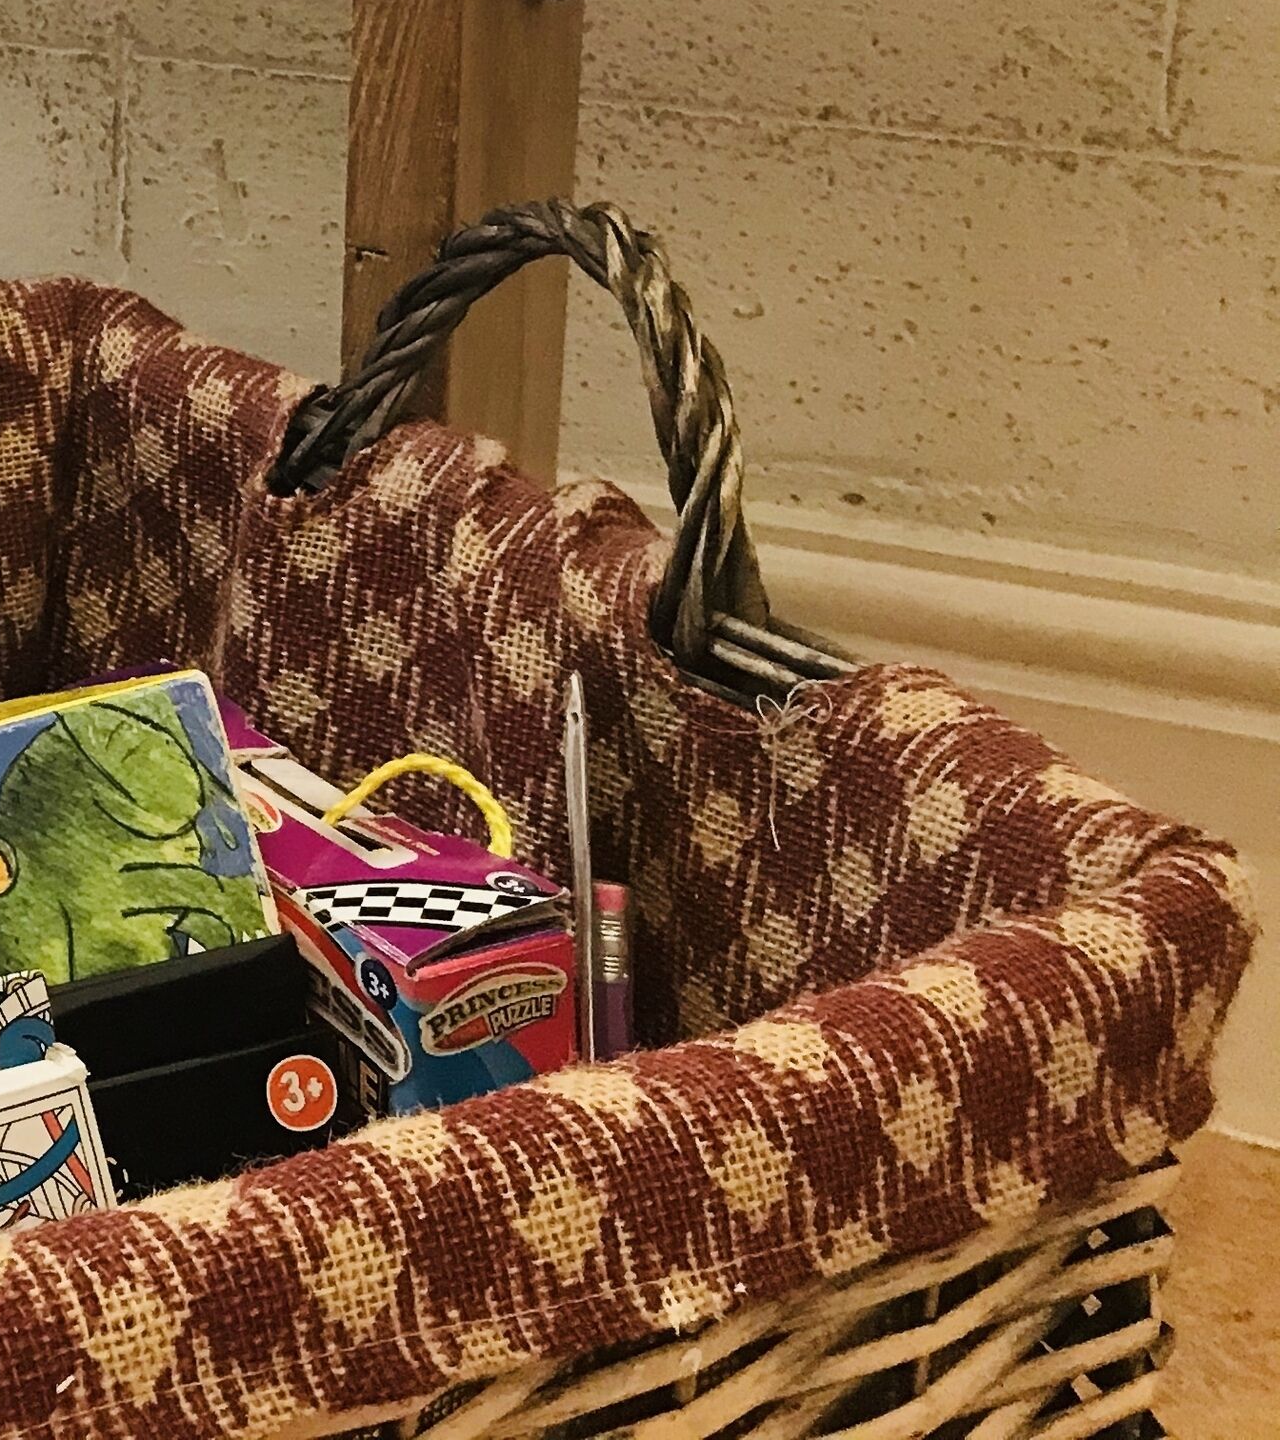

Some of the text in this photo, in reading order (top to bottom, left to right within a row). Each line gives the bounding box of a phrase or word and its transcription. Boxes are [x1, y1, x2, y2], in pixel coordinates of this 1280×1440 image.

[369, 971, 390, 999] 3+
[426, 979, 562, 1040] PRINCESS
[490, 996, 552, 1035] PUZZLE
[279, 1070, 324, 1113] 3+
